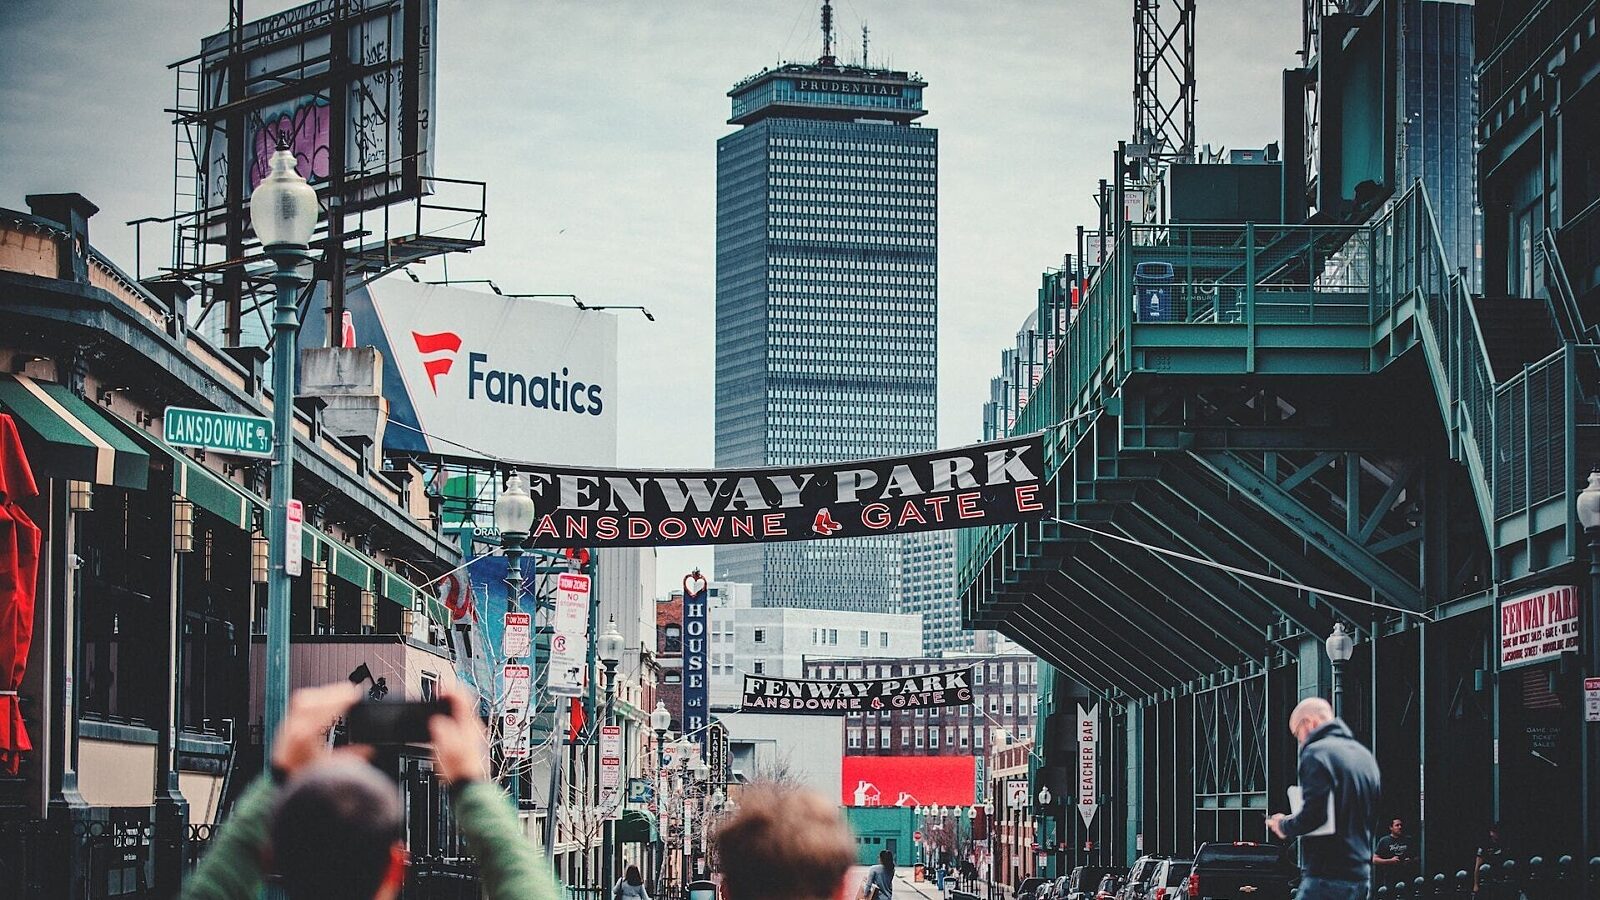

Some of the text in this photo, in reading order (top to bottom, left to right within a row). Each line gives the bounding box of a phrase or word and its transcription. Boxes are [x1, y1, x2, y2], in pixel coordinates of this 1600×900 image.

[800, 80, 899, 96] PRUDENTIAL
[468, 351, 603, 416] Fanatics
[168, 413, 269, 451] LANSDOWNE ST
[512, 445, 1039, 512] FENWAY PARK
[529, 485, 1043, 540] ANSDOWNE GATE E
[473, 528, 501, 536] ORAN
[567, 593, 579, 601] NO
[1502, 594, 1546, 637] FENWAY
[687, 603, 704, 688] HOUSE
[1524, 645, 1539, 658] STREET
[744, 671, 969, 698] FENWAY PARK
[688, 696, 703, 707] of
[743, 688, 971, 710] LANSDOWNE GATE C
[1083, 720, 1093, 742] BAR
[1083, 746, 1093, 805] BLEACHER
[631, 781, 646, 799] P
